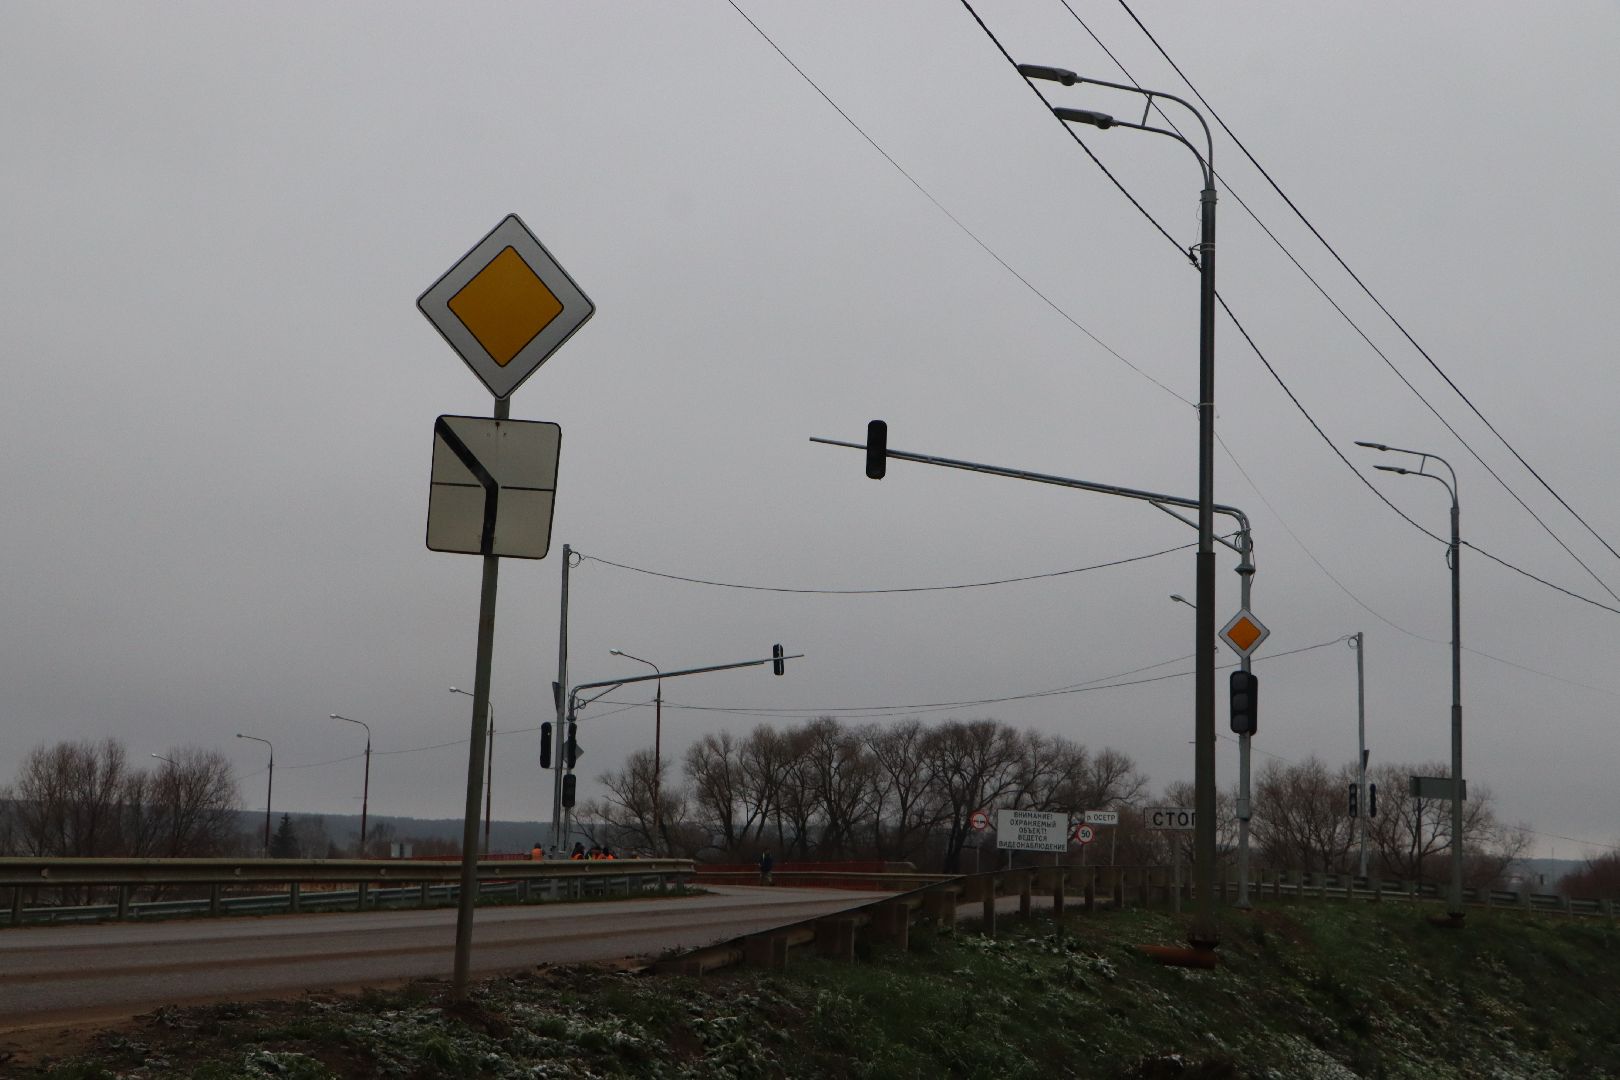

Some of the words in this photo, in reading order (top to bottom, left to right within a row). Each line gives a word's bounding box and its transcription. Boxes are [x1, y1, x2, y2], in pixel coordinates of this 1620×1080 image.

[1014, 812, 1052, 820] ВНИМАНИЕ!
[1010, 819, 1056, 828] ОХРАНЯЕМЫЙ
[1018, 826, 1046, 834] ОБЪЕКТ!
[999, 840, 1066, 850] ВИДЕОНАБЛЮДЕНИЕ
